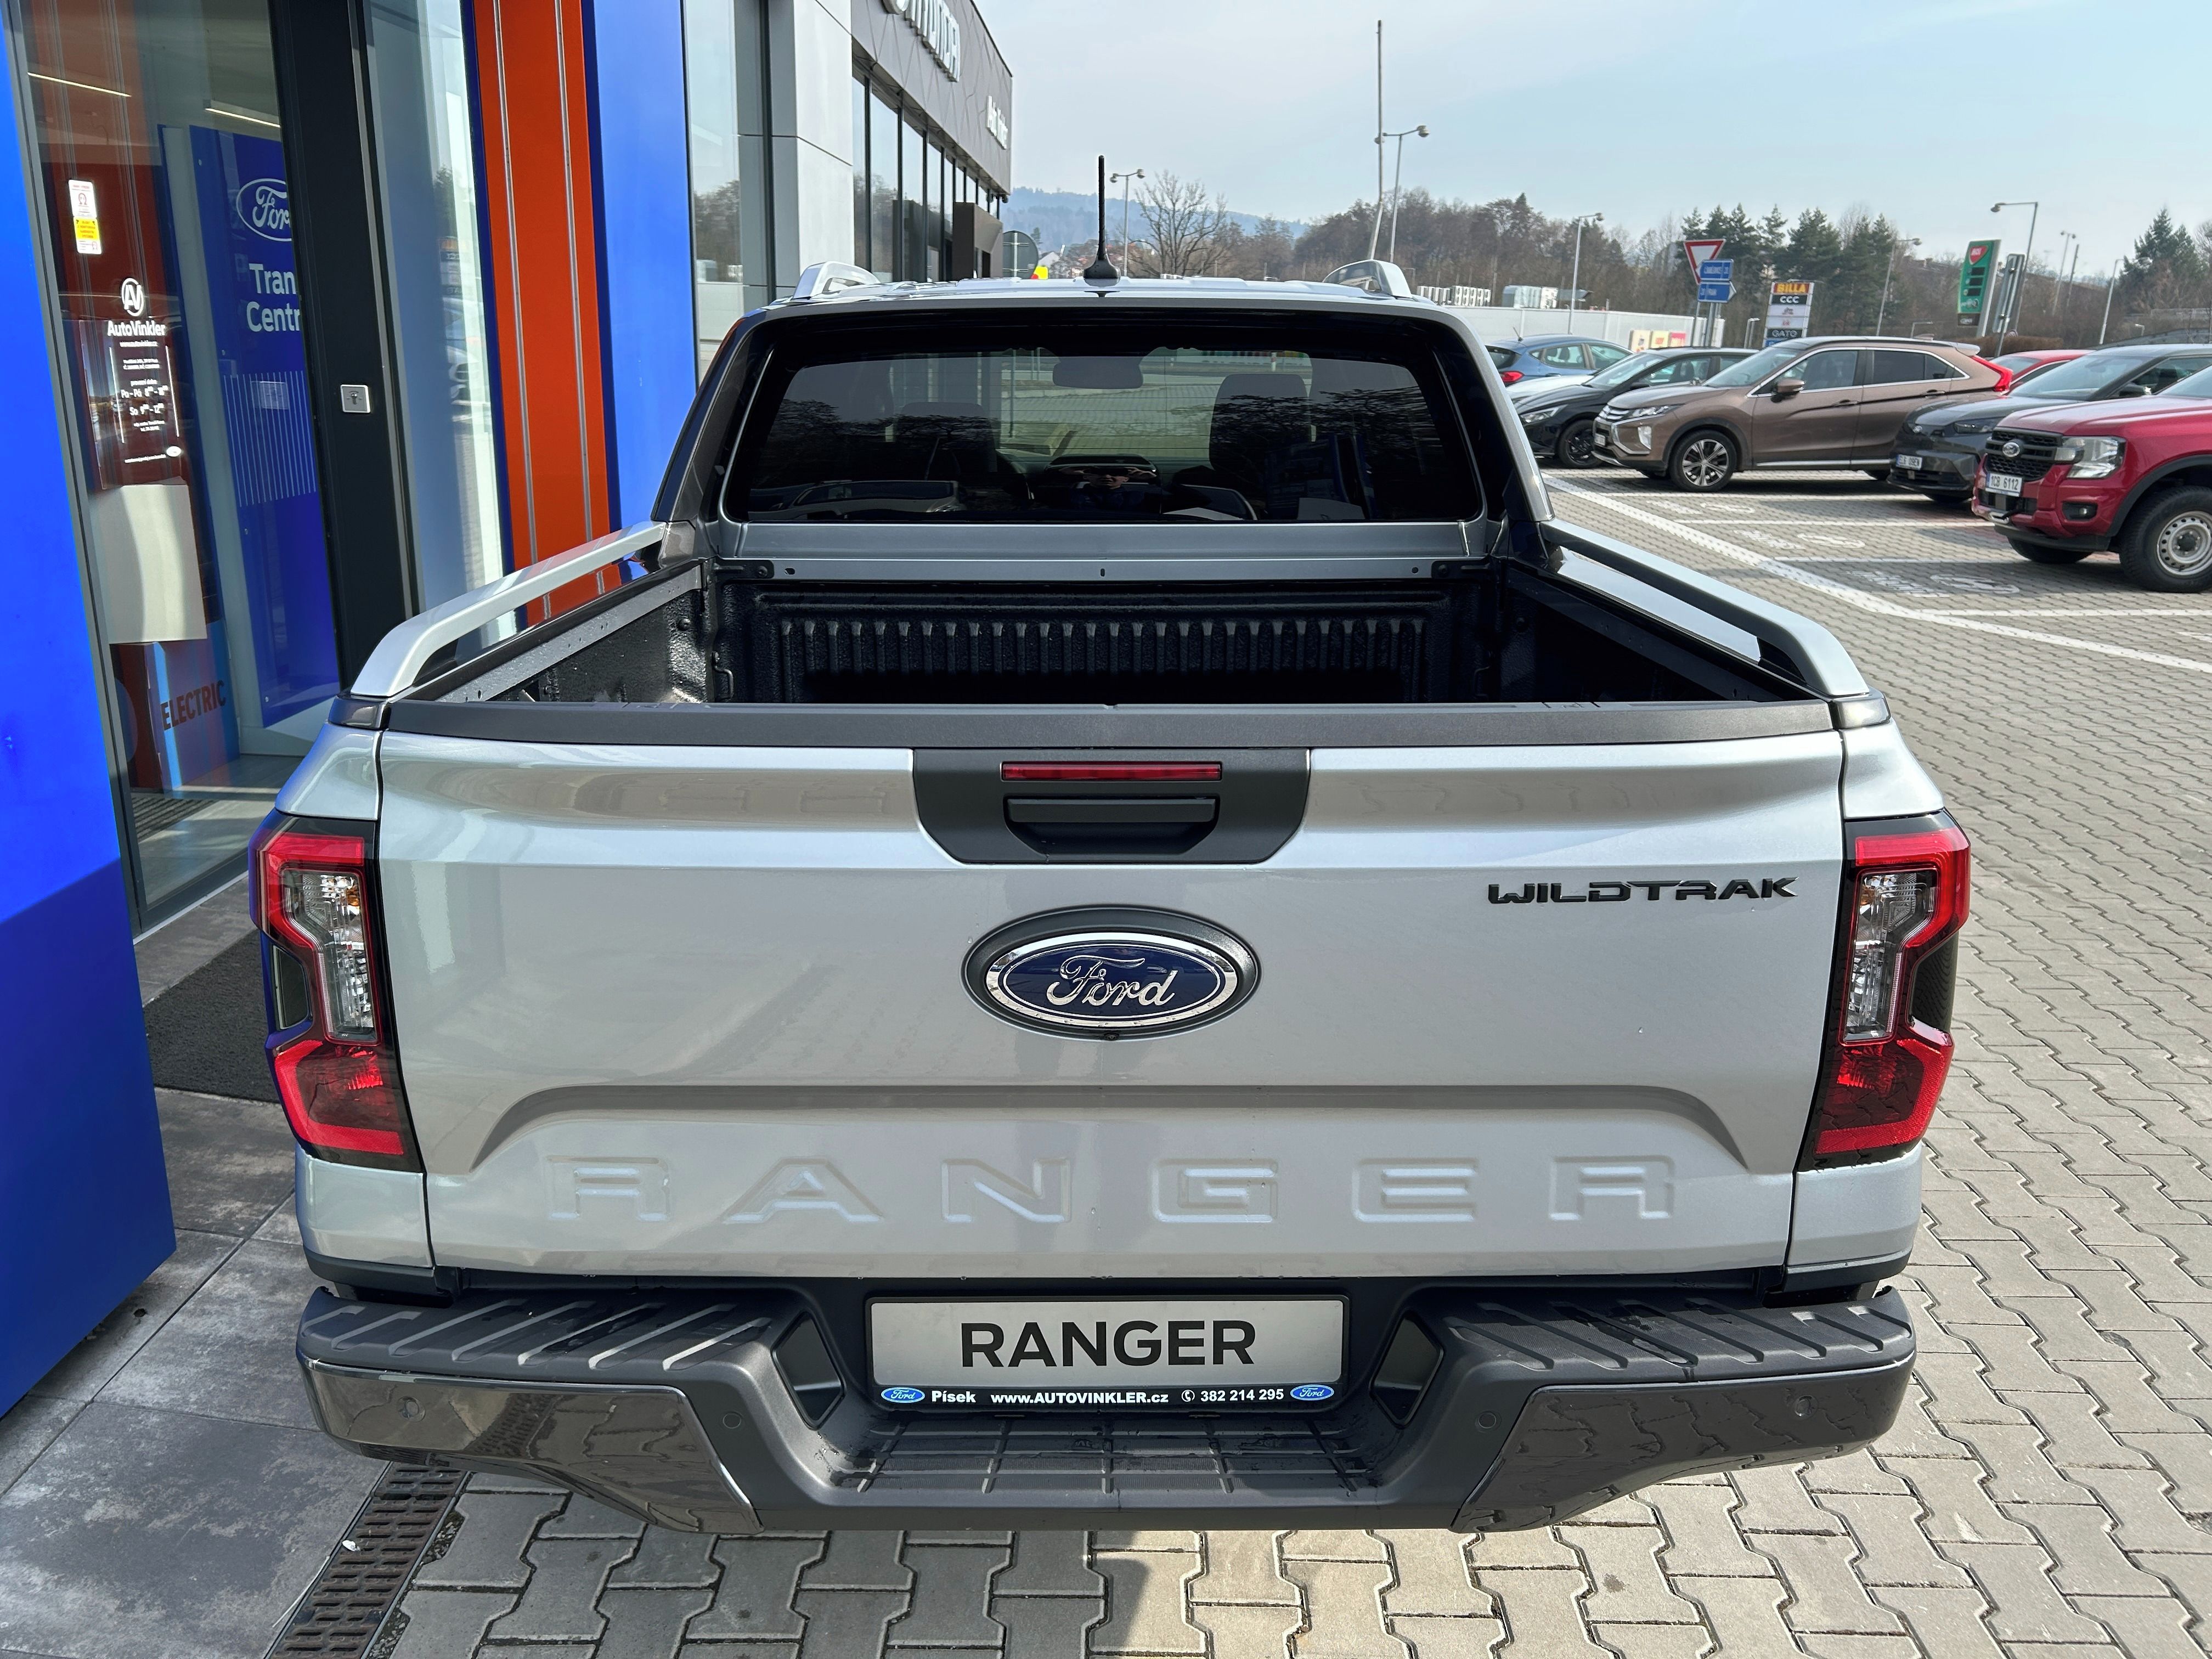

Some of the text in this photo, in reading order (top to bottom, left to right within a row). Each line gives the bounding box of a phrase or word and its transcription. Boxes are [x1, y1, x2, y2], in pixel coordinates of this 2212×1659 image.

[252, 185, 291, 229] For
[249, 263, 296, 294] Tran
[108, 320, 166, 336] AutoVinkler
[247, 301, 300, 332] Centr
[2003, 477, 2019, 490] 6112
[160, 680, 227, 731] ELECTRIC
[1487, 876, 1798, 905] WILDTRAK
[1046, 955, 1179, 1006] Ford
[546, 1156, 1675, 1223] RANGER
[961, 1319, 1256, 1368] RANGER
[890, 1387, 1324, 1404] Ford Písek www.AUTOVINKLER.cz 382 214 295 Ford
